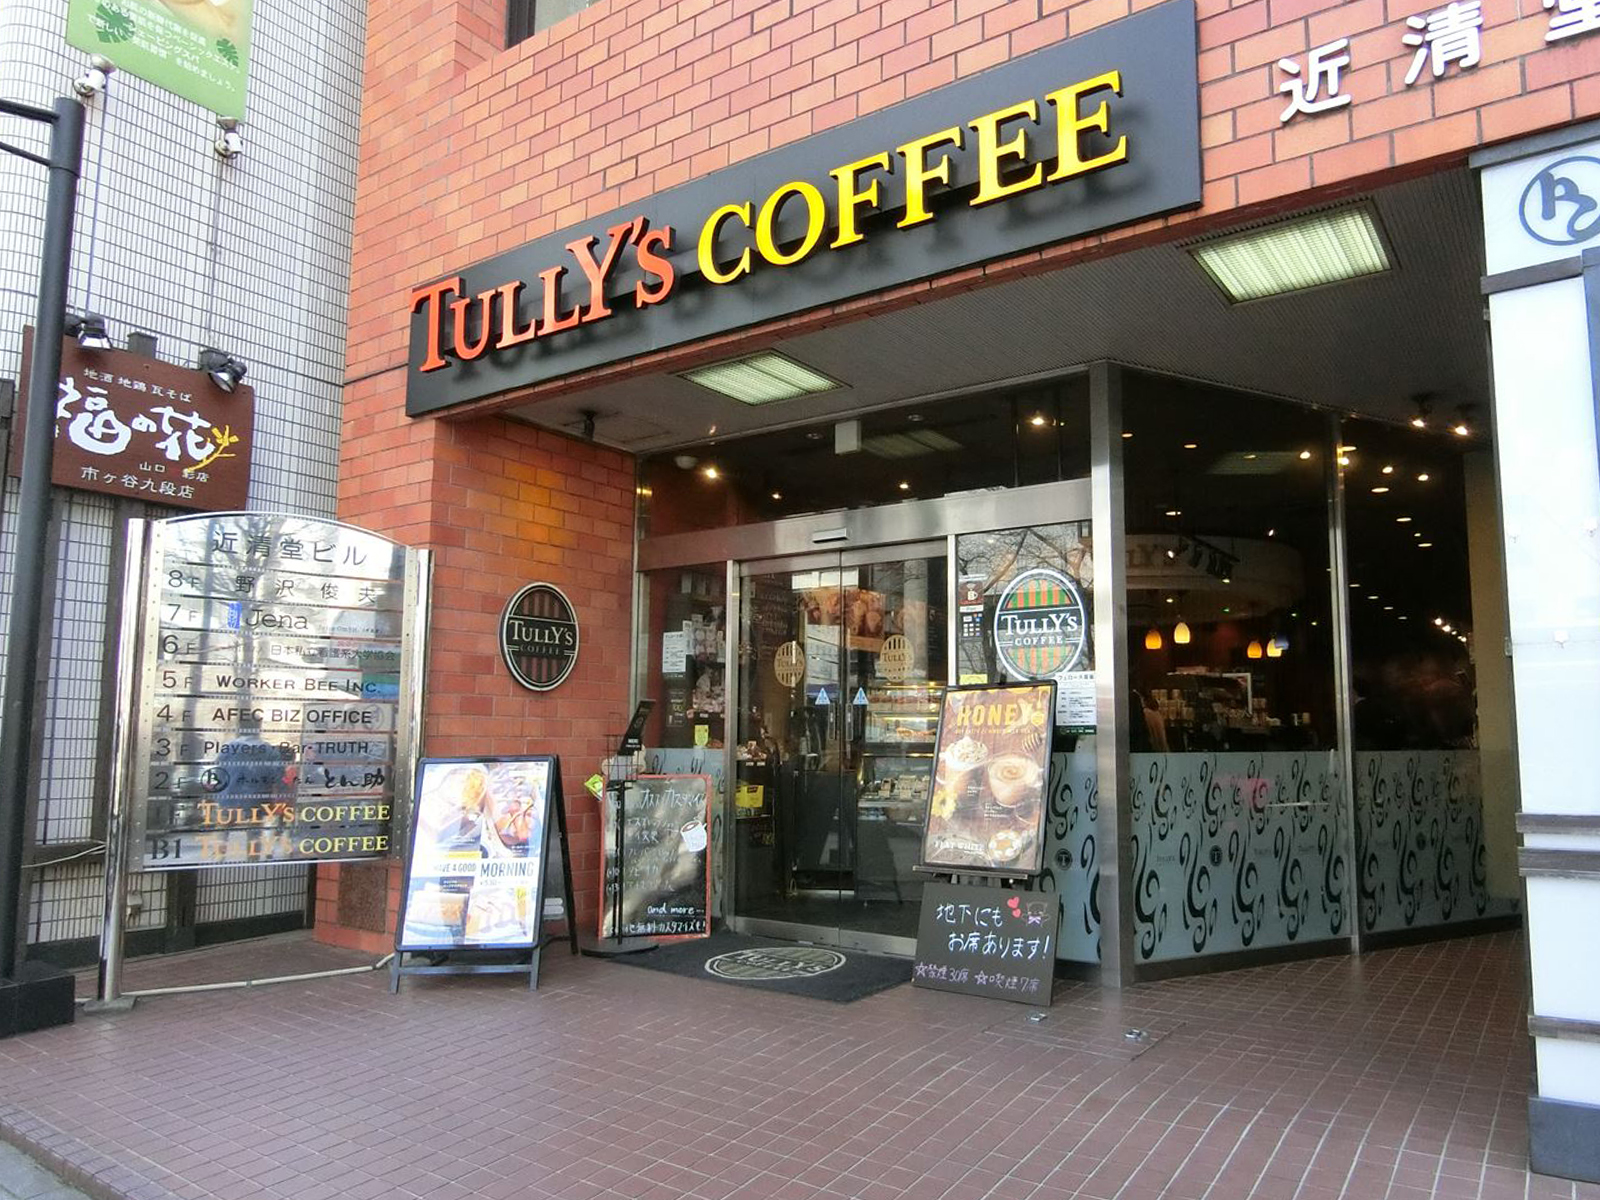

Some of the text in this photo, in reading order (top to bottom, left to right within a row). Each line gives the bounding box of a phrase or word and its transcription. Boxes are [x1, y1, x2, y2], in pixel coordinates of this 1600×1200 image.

[411, 70, 1130, 373] TULLY'S COFFEE
[83, 367, 114, 384] 地酒
[151, 384, 193, 403] 瓦そば
[139, 461, 166, 474] 山口
[212, 530, 367, 567] 近清堂ビル
[245, 608, 309, 630] Jena
[1000, 612, 1078, 636] TULLY'S
[508, 620, 574, 646] TULLY'S
[1014, 635, 1064, 647] COFFEE
[216, 674, 296, 691] WORKER
[305, 677, 338, 692] BEE
[212, 707, 264, 723] AFEC
[271, 708, 300, 723] BIZ
[306, 709, 373, 724] OFFICE
[197, 799, 296, 825] TULLY'S
[301, 804, 391, 822] COFFEE
[151, 838, 183, 860] B1
[299, 834, 390, 854] COFFEE
[480, 861, 535, 878] MORNING
[647, 902, 667, 915] and
[936, 904, 1003, 928] 地下にも
[948, 930, 1050, 960] お席あります!
